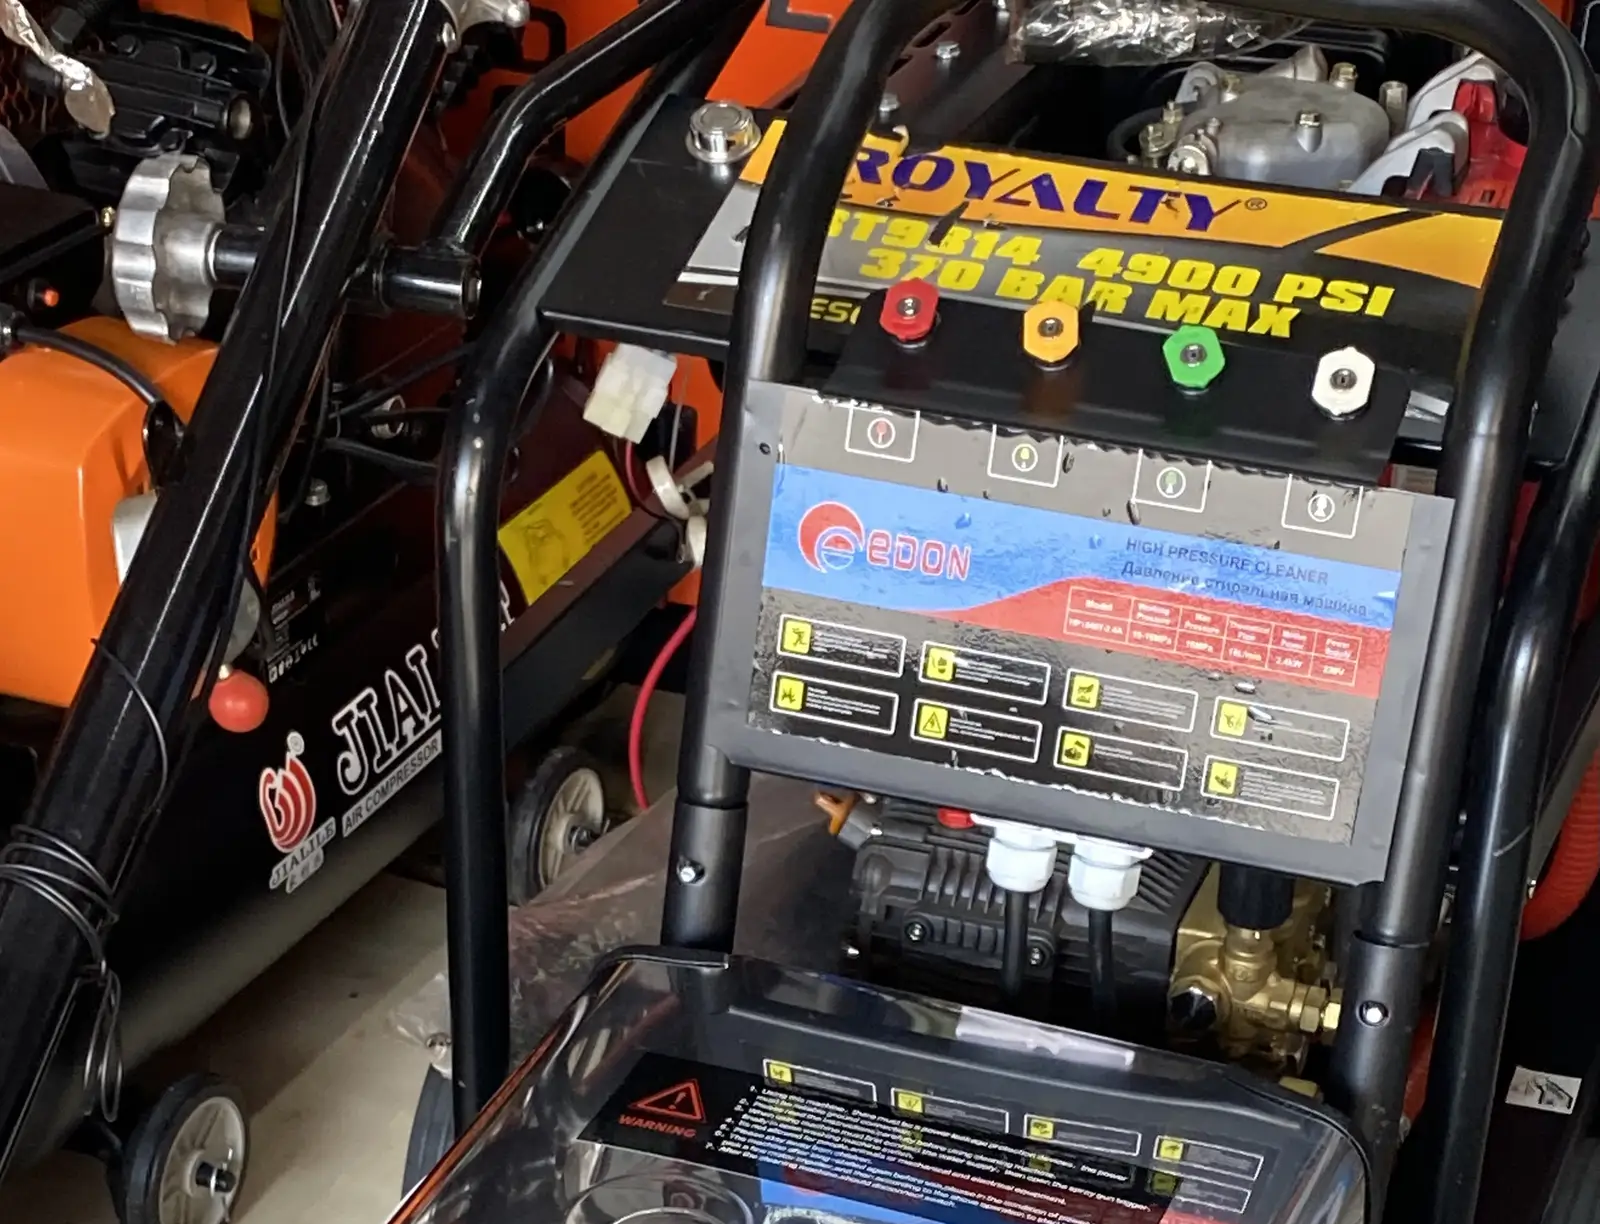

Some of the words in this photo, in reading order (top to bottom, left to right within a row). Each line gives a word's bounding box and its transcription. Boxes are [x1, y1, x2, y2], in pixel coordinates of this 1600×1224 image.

[841, 146, 1241, 232] ROYALTY
[859, 248, 985, 292] 370
[995, 268, 1133, 314] BAR
[1145, 289, 1301, 339] MAX
[1076, 247, 1261, 298] 4900
[1273, 273, 1395, 318] PSI
[1126, 537, 1164, 557] HIGH
[1167, 546, 1250, 572] PRESSURE
[1254, 561, 1329, 586] CLEANER
[344, 807, 364, 834] AIR
[365, 738, 439, 814] COMPRESSOR
[618, 1113, 697, 1139] WARNING
